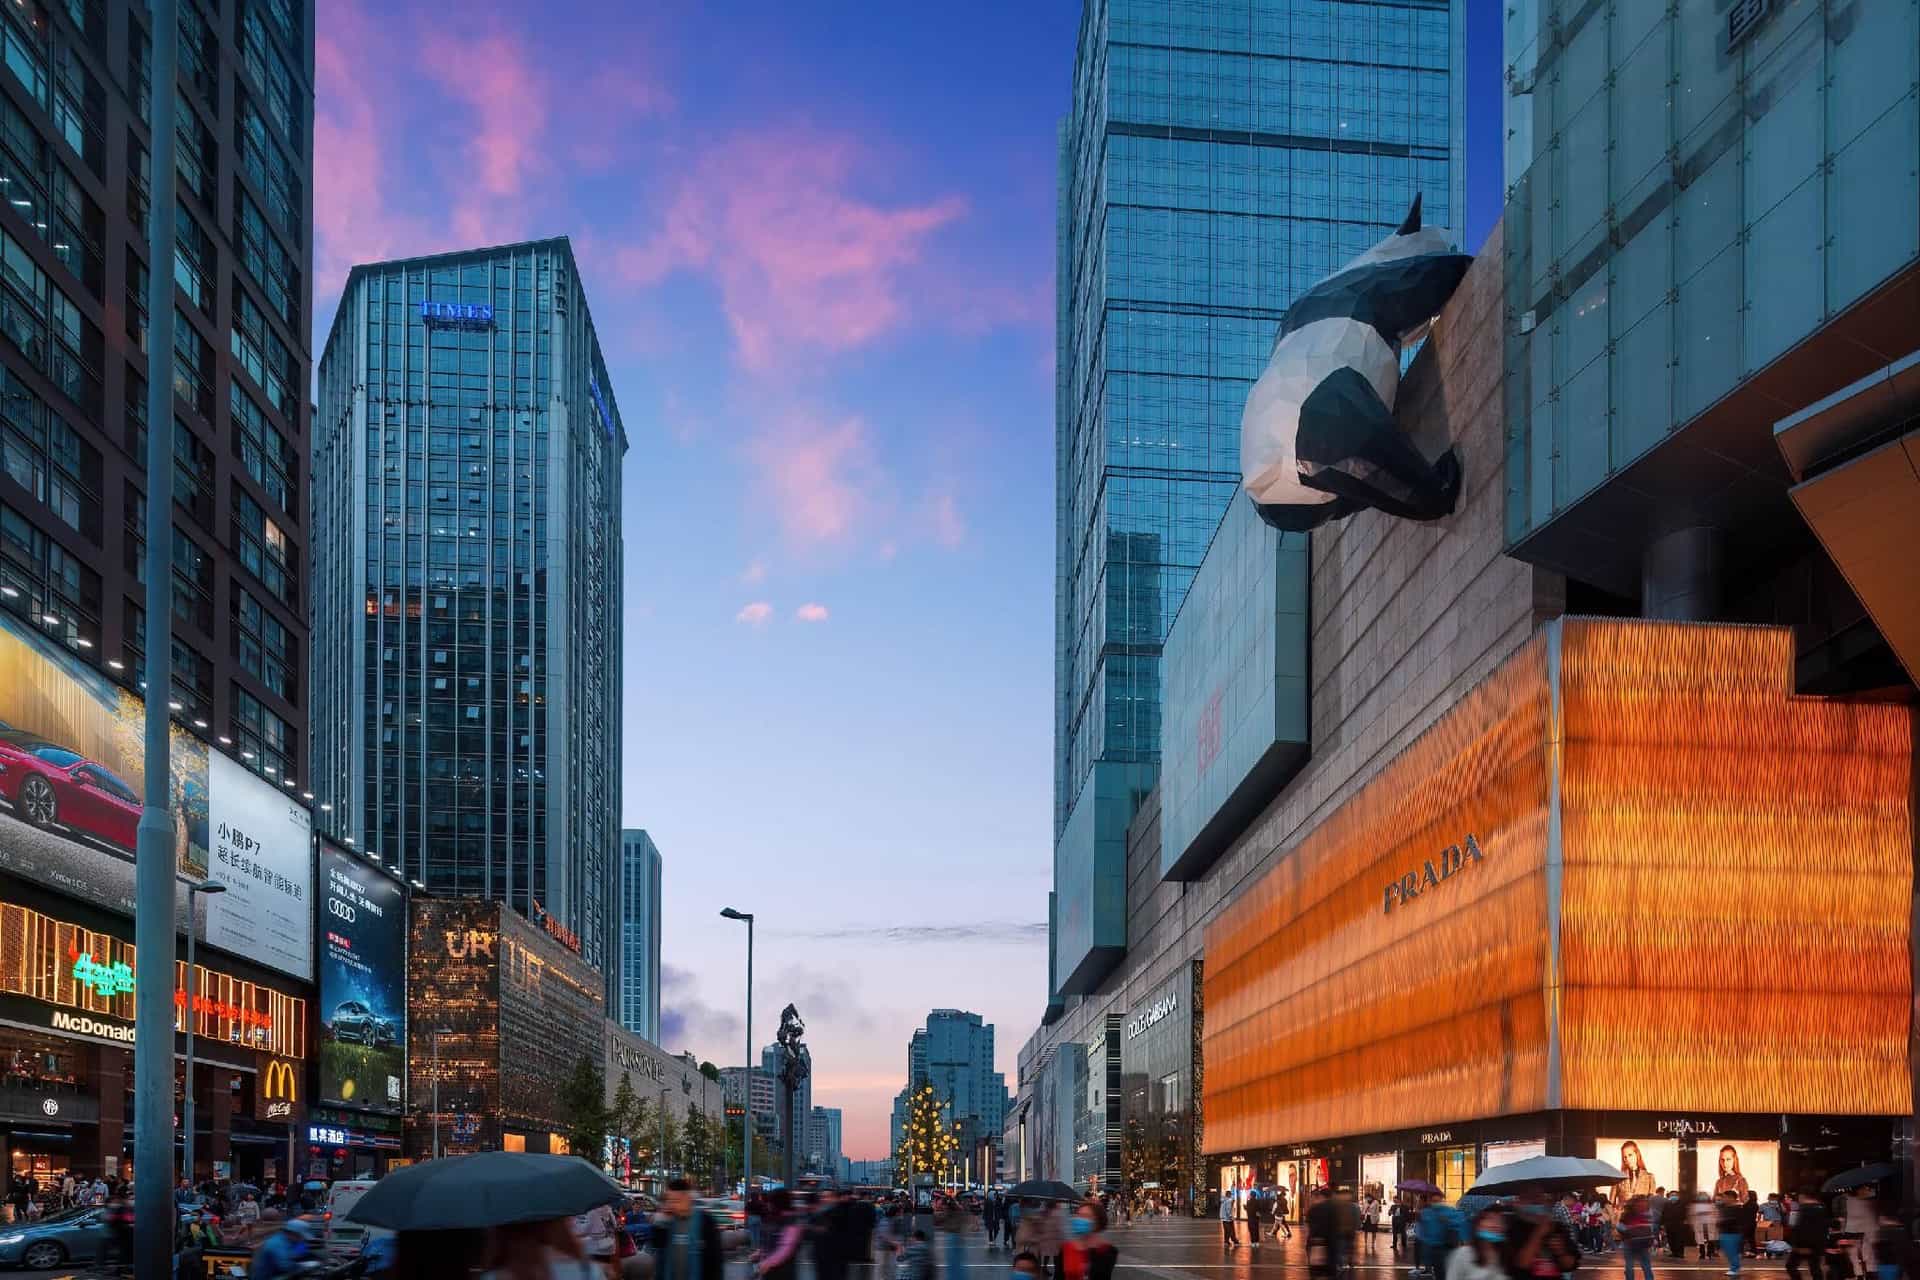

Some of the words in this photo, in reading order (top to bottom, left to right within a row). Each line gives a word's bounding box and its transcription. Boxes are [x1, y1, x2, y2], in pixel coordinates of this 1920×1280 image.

[421, 302, 493, 319] TIMES
[218, 822, 260, 856] 小鹏P7
[1383, 833, 1483, 915] PRADA
[445, 928, 495, 959] UR
[1421, 1131, 1452, 1144] PRADA
[1657, 1120, 1720, 1134] PRADA
